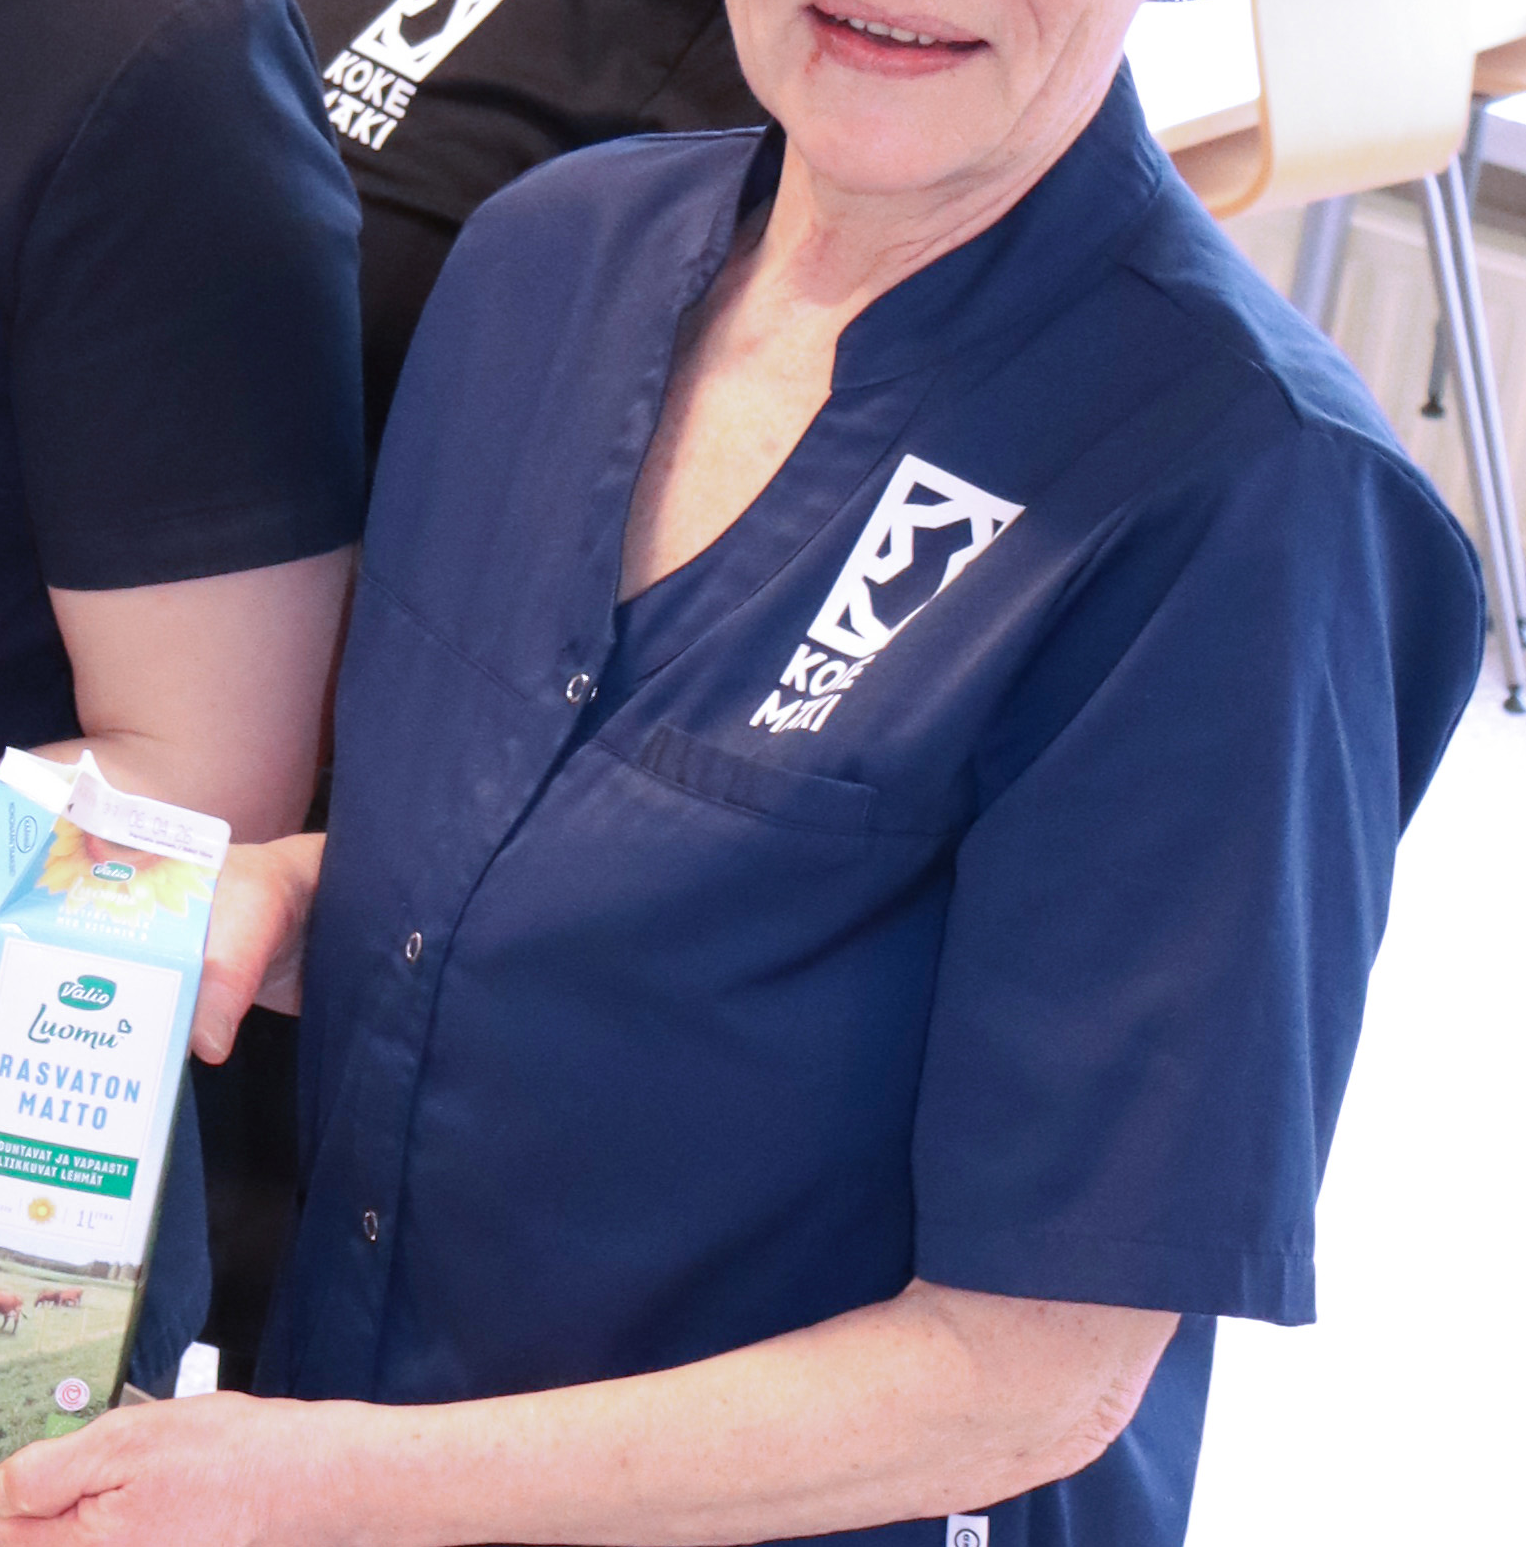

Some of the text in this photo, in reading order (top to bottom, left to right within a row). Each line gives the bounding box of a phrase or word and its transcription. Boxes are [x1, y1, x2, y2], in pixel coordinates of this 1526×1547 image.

[323, 50, 417, 119] KOKE
[60, 983, 110, 1005] Valio
[27, 1003, 119, 1049] Luomu
[18, 1091, 108, 1130] MAITO
[54, 1154, 70, 1166] JA
[73, 1156, 129, 1177] VAPAASTI
[60, 1167, 104, 1186] LEHMÄT
